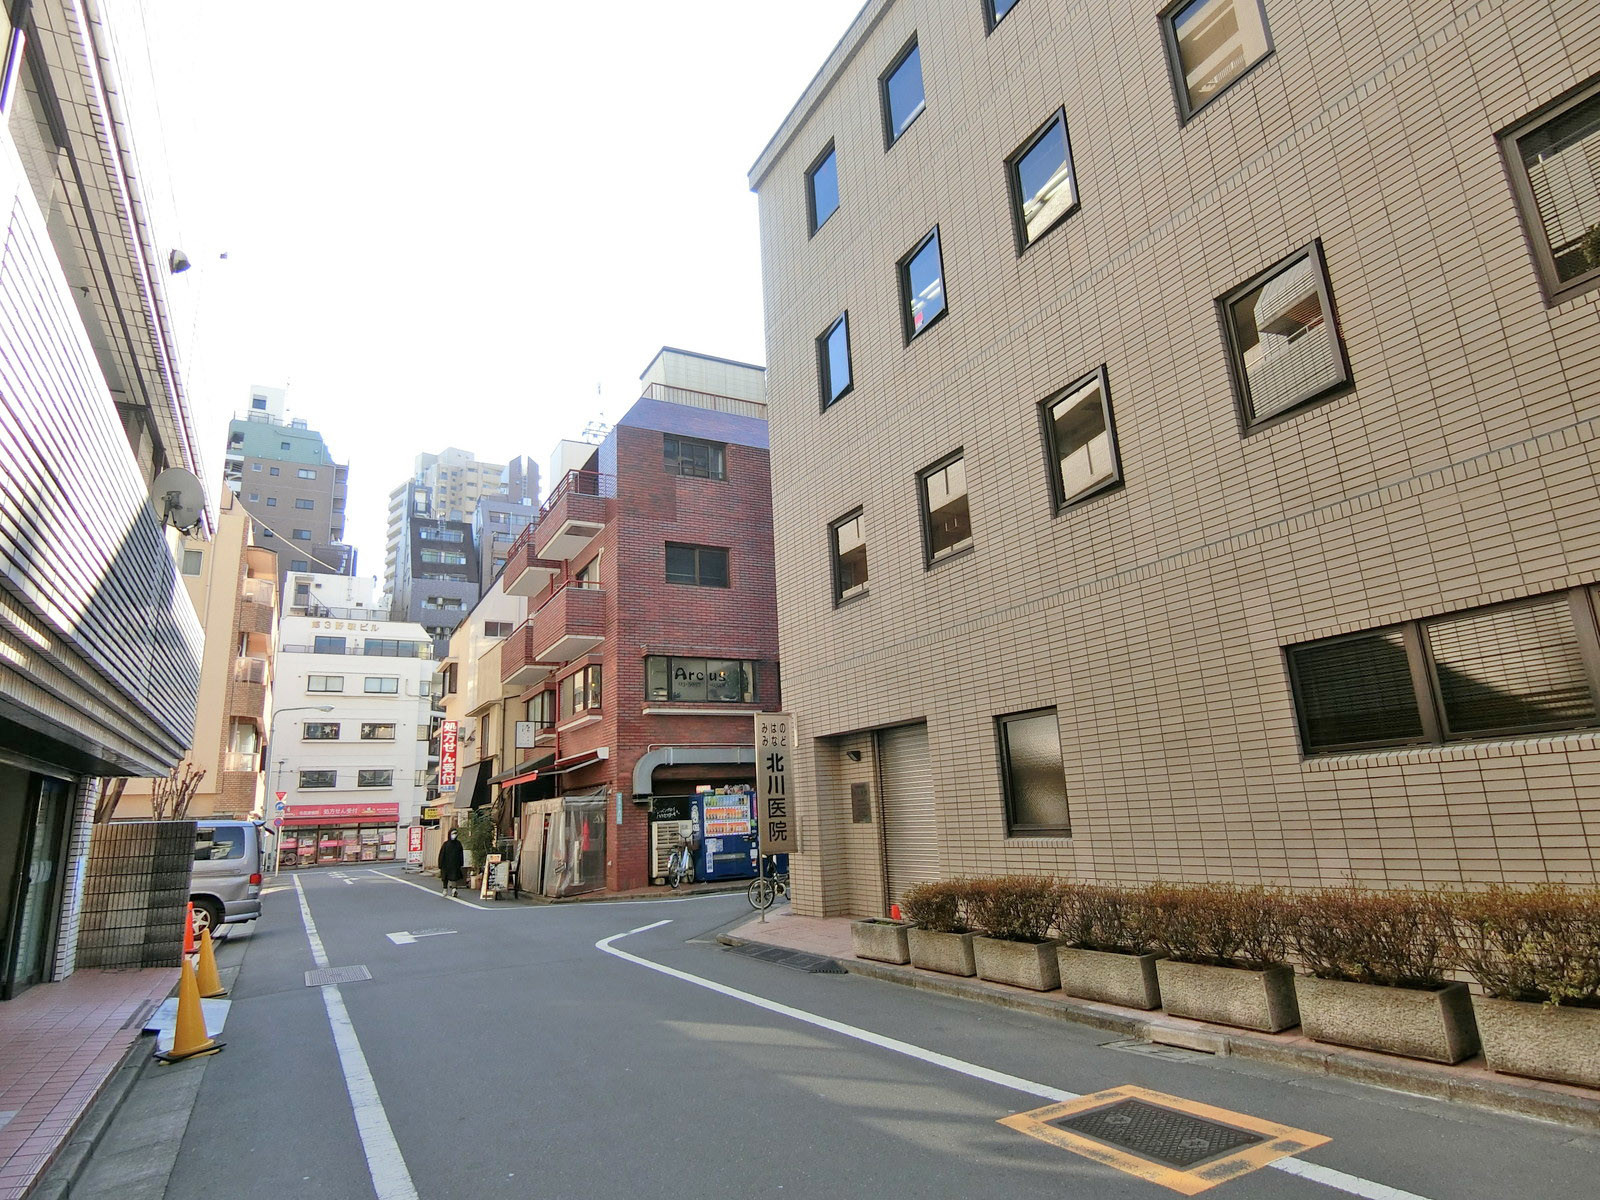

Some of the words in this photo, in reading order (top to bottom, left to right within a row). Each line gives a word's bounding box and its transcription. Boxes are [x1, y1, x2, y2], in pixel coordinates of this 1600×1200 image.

[674, 667, 726, 681] Arcus
[442, 721, 457, 784] 処方せん受付
[766, 752, 787, 842] 北川医院
